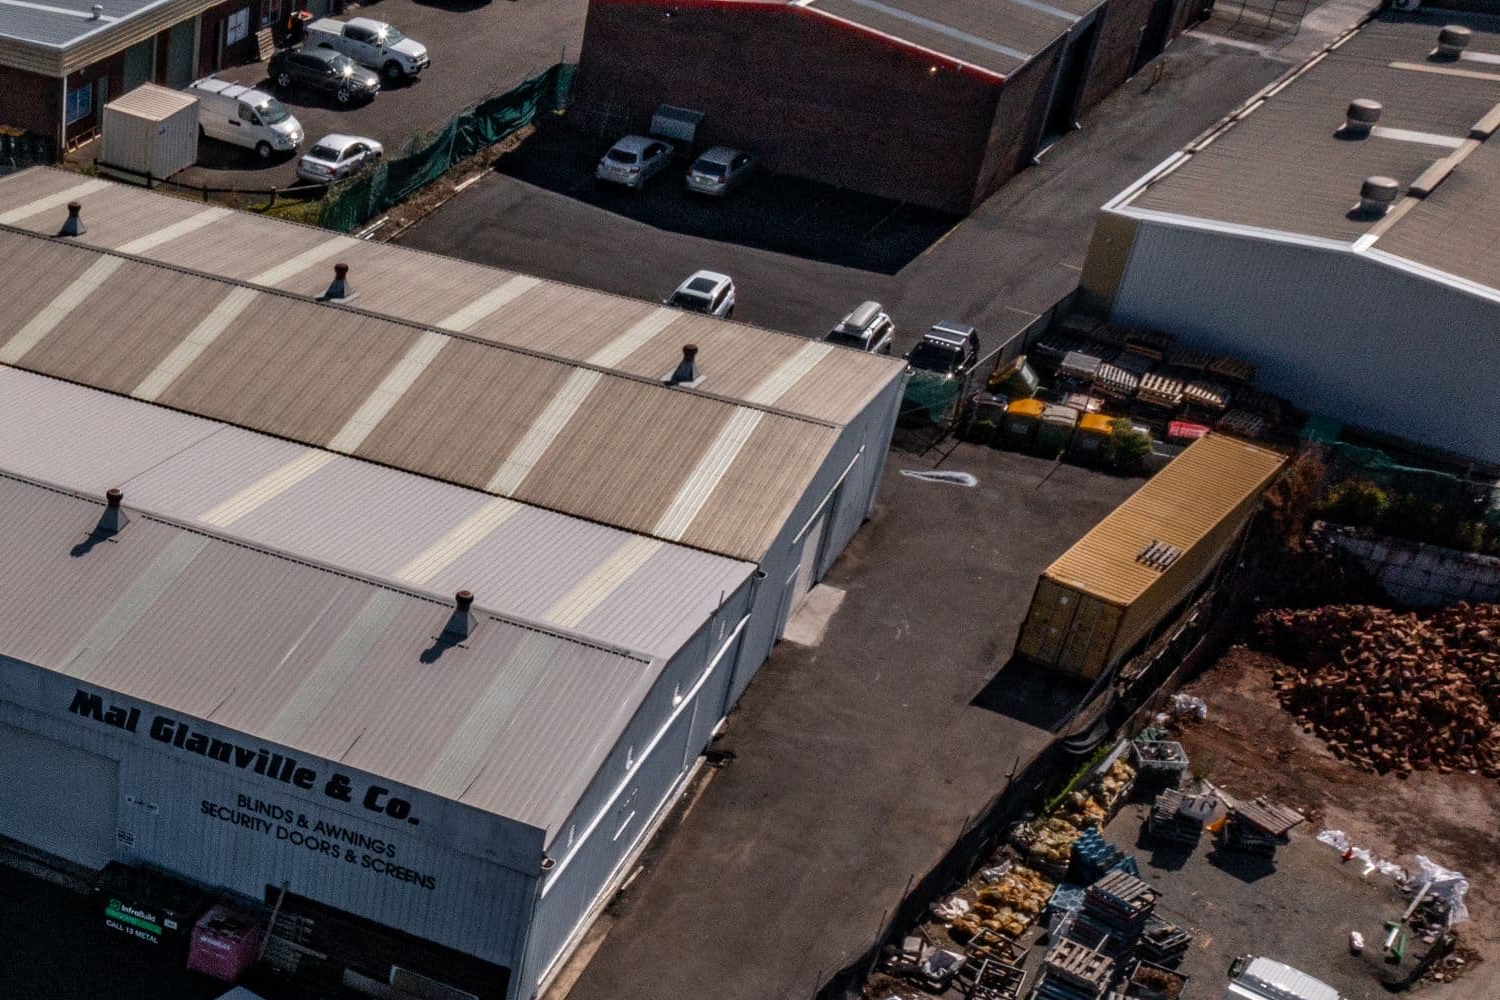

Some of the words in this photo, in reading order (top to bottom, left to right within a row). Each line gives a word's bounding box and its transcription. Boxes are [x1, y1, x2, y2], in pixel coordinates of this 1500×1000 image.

[69, 689, 141, 733] Mal
[149, 716, 317, 790] Glanville
[324, 773, 352, 803] &
[363, 785, 420, 826] Co.
[201, 800, 273, 835] SECURITY
[276, 825, 341, 859] DOORS
[344, 848, 358, 865] &
[361, 854, 437, 891] SCREENS
[238, 793, 294, 824] BLINDS
[297, 814, 309, 829] &
[313, 820, 397, 859] AWNINGS
